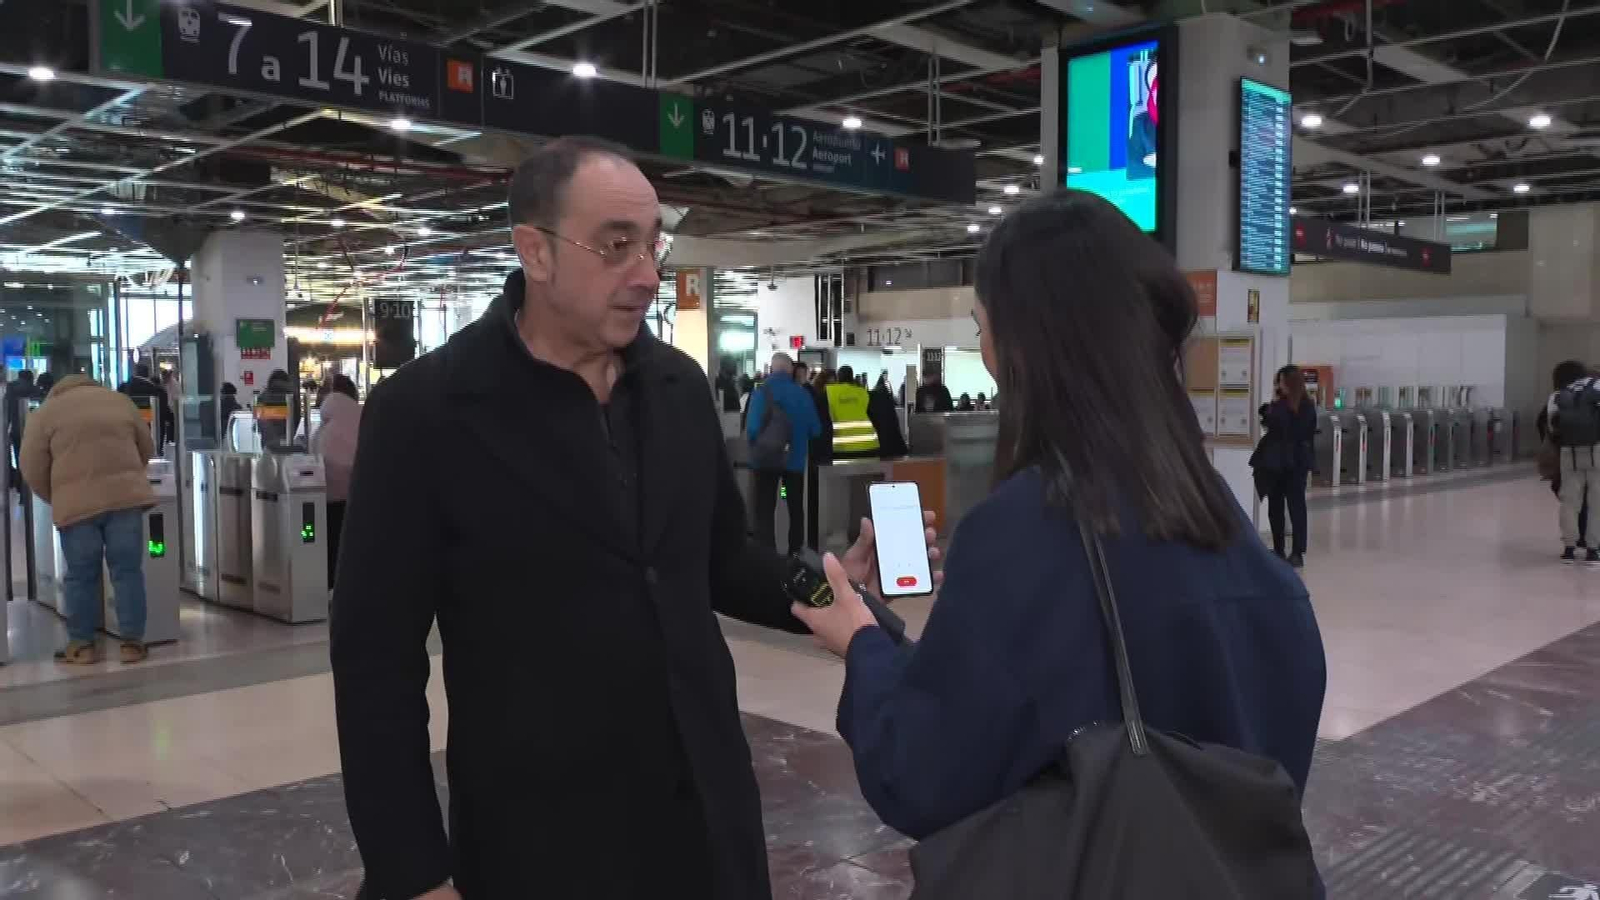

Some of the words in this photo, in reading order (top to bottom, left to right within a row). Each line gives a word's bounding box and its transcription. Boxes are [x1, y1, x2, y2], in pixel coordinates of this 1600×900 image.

[218, 12, 252, 74] 7
[261, 55, 281, 82] a
[298, 30, 370, 95] 14
[378, 67, 410, 88] Vies
[686, 274, 700, 296] R
